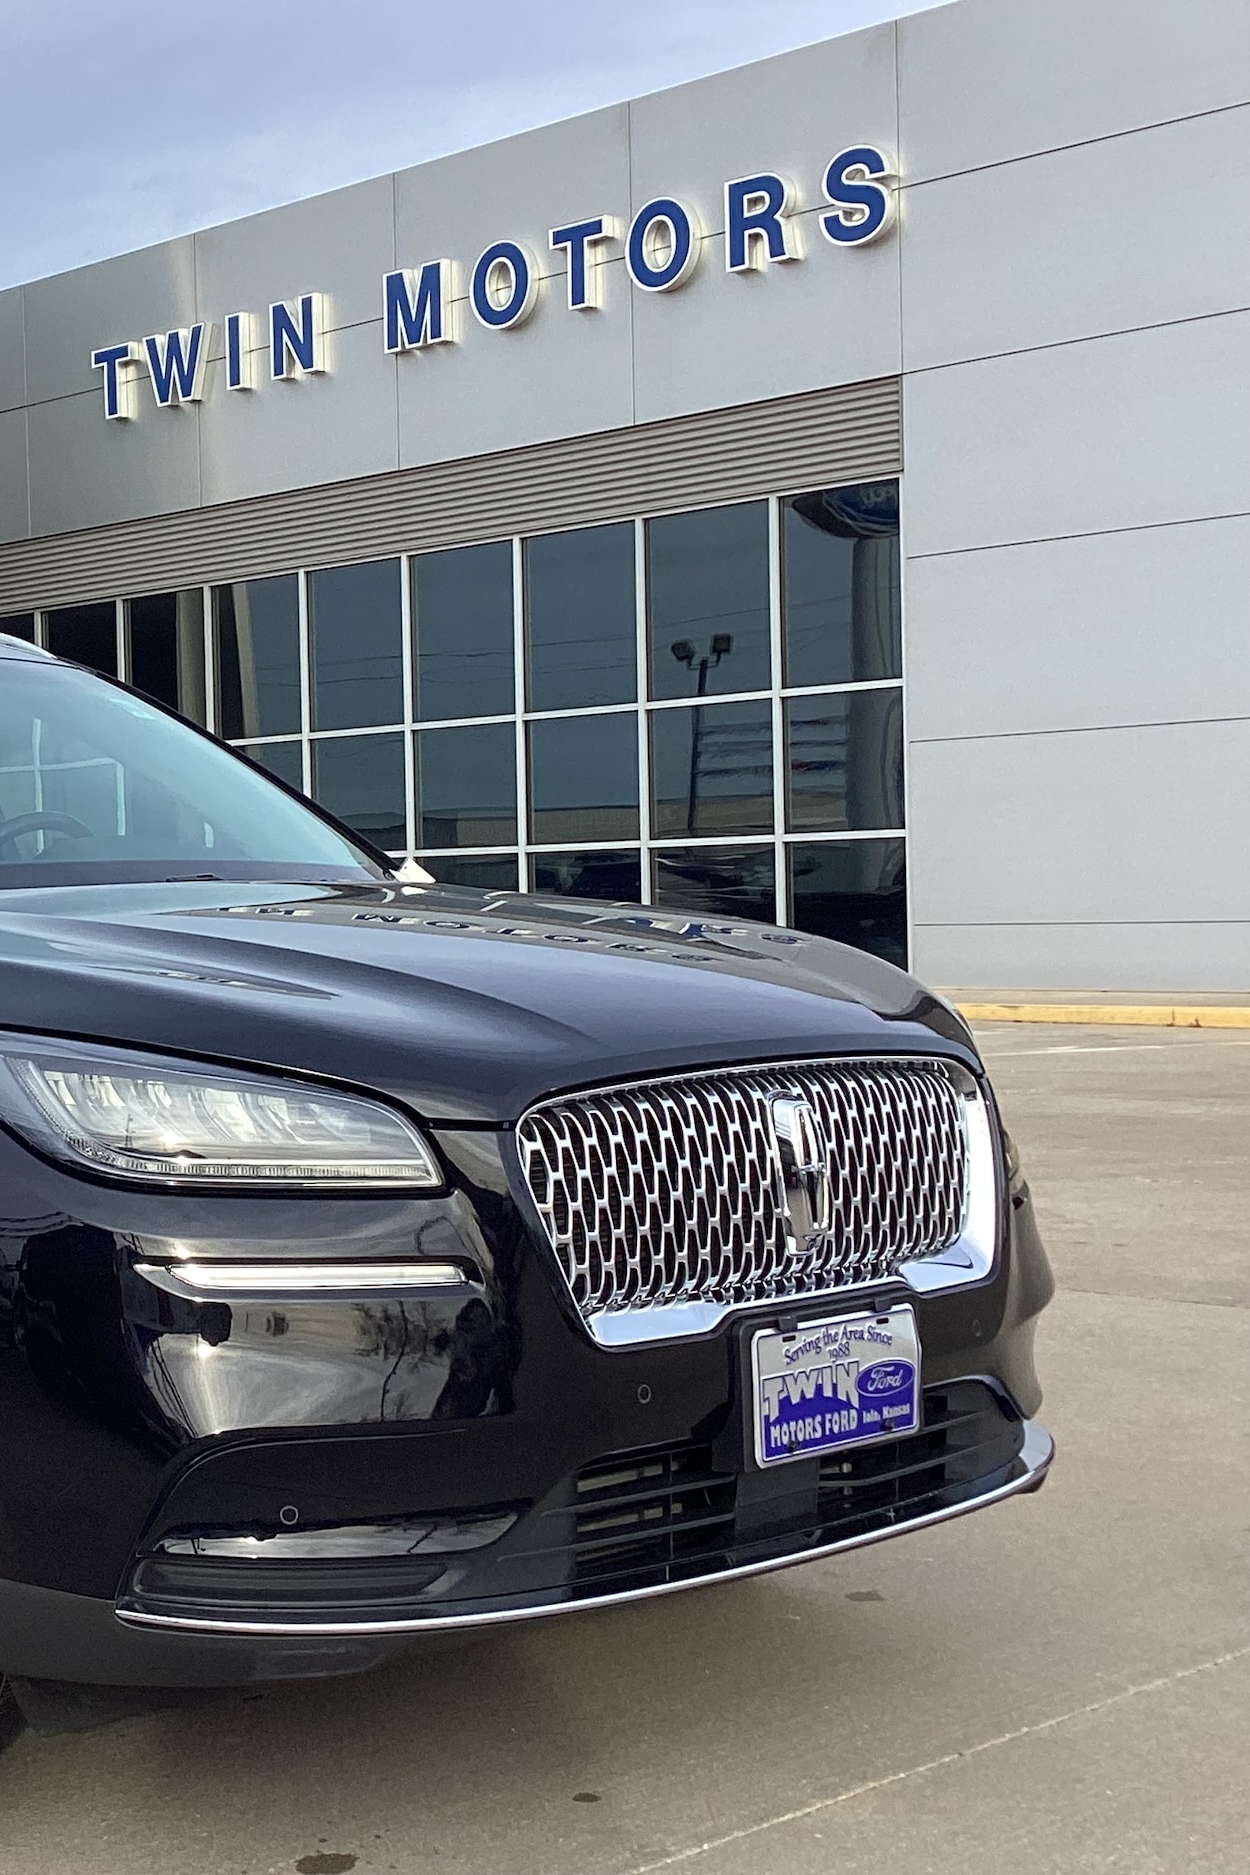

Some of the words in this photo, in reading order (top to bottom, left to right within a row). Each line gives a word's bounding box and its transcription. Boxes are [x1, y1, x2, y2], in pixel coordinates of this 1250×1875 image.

[91, 292, 323, 420] TWIN
[384, 143, 892, 354] MOTORS
[784, 1335, 822, 1365] Serving
[823, 1326, 839, 1346] the
[840, 1324, 866, 1342] Area
[866, 1325, 893, 1346] Since
[827, 1340, 851, 1359] 1988
[762, 1361, 860, 1423] TWIN
[867, 1366, 904, 1391] Ford
[770, 1414, 823, 1448] MOTORS
[825, 1409, 858, 1436] FORD
